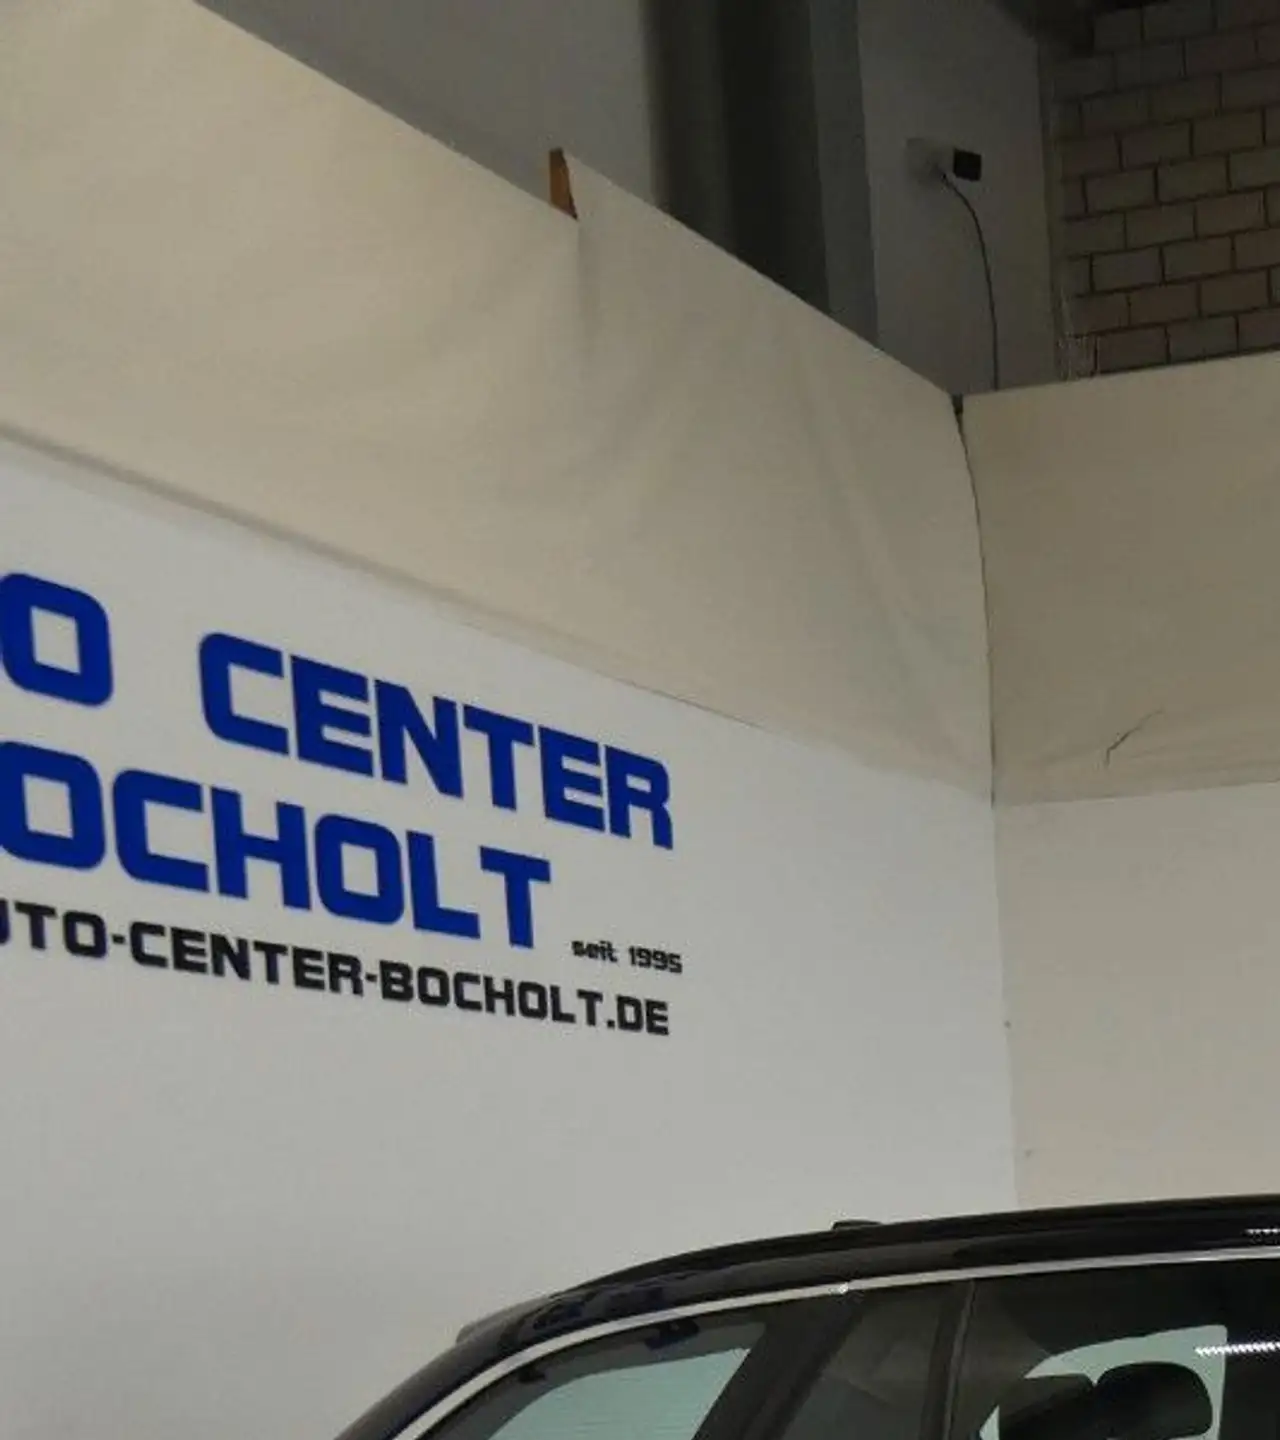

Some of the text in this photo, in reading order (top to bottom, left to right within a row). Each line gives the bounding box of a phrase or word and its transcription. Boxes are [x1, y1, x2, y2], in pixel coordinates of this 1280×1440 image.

[200, 633, 673, 850] CENTER
[571, 940, 683, 974] seit 1995
